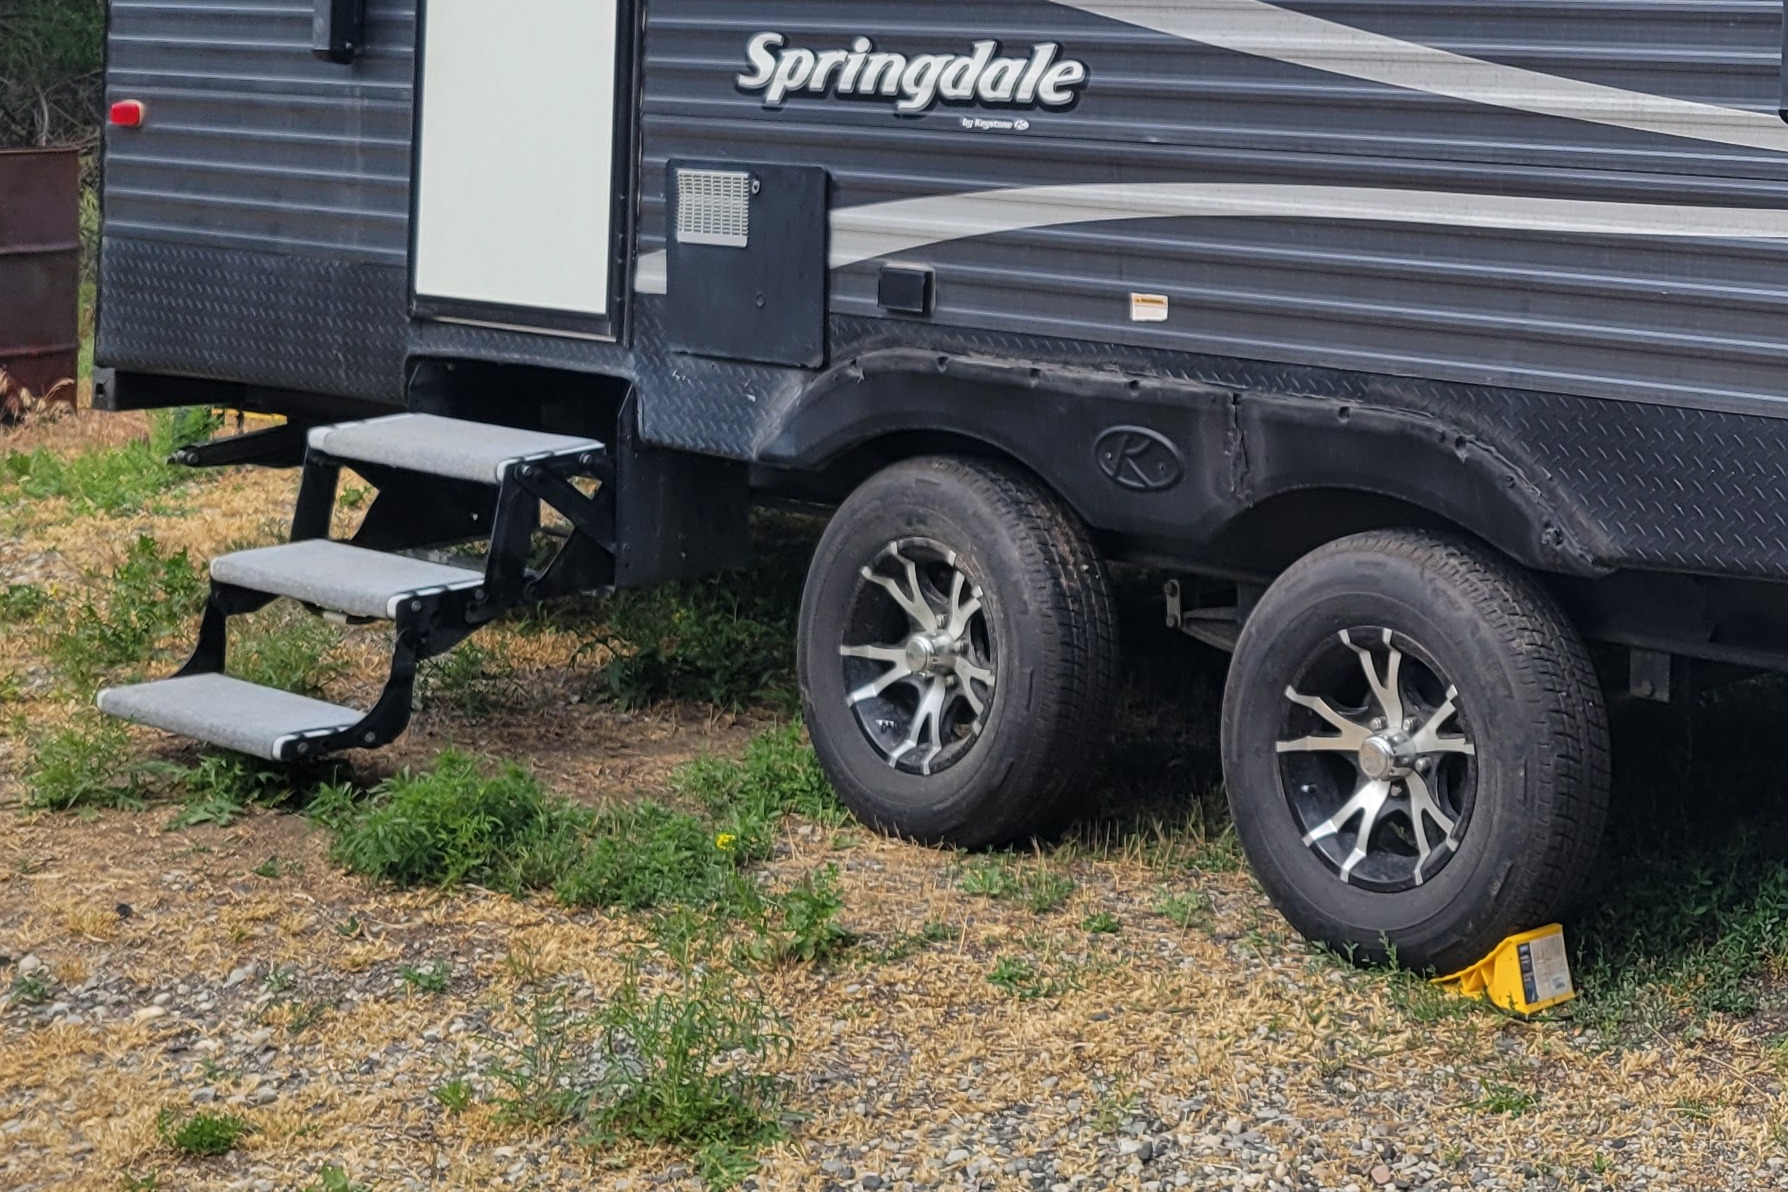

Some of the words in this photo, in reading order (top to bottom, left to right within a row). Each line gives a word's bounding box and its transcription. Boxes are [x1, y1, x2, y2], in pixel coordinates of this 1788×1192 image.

[736, 31, 1087, 114] Springdale
[962, 117, 974, 129] by
[974, 118, 1013, 130] Keystone
